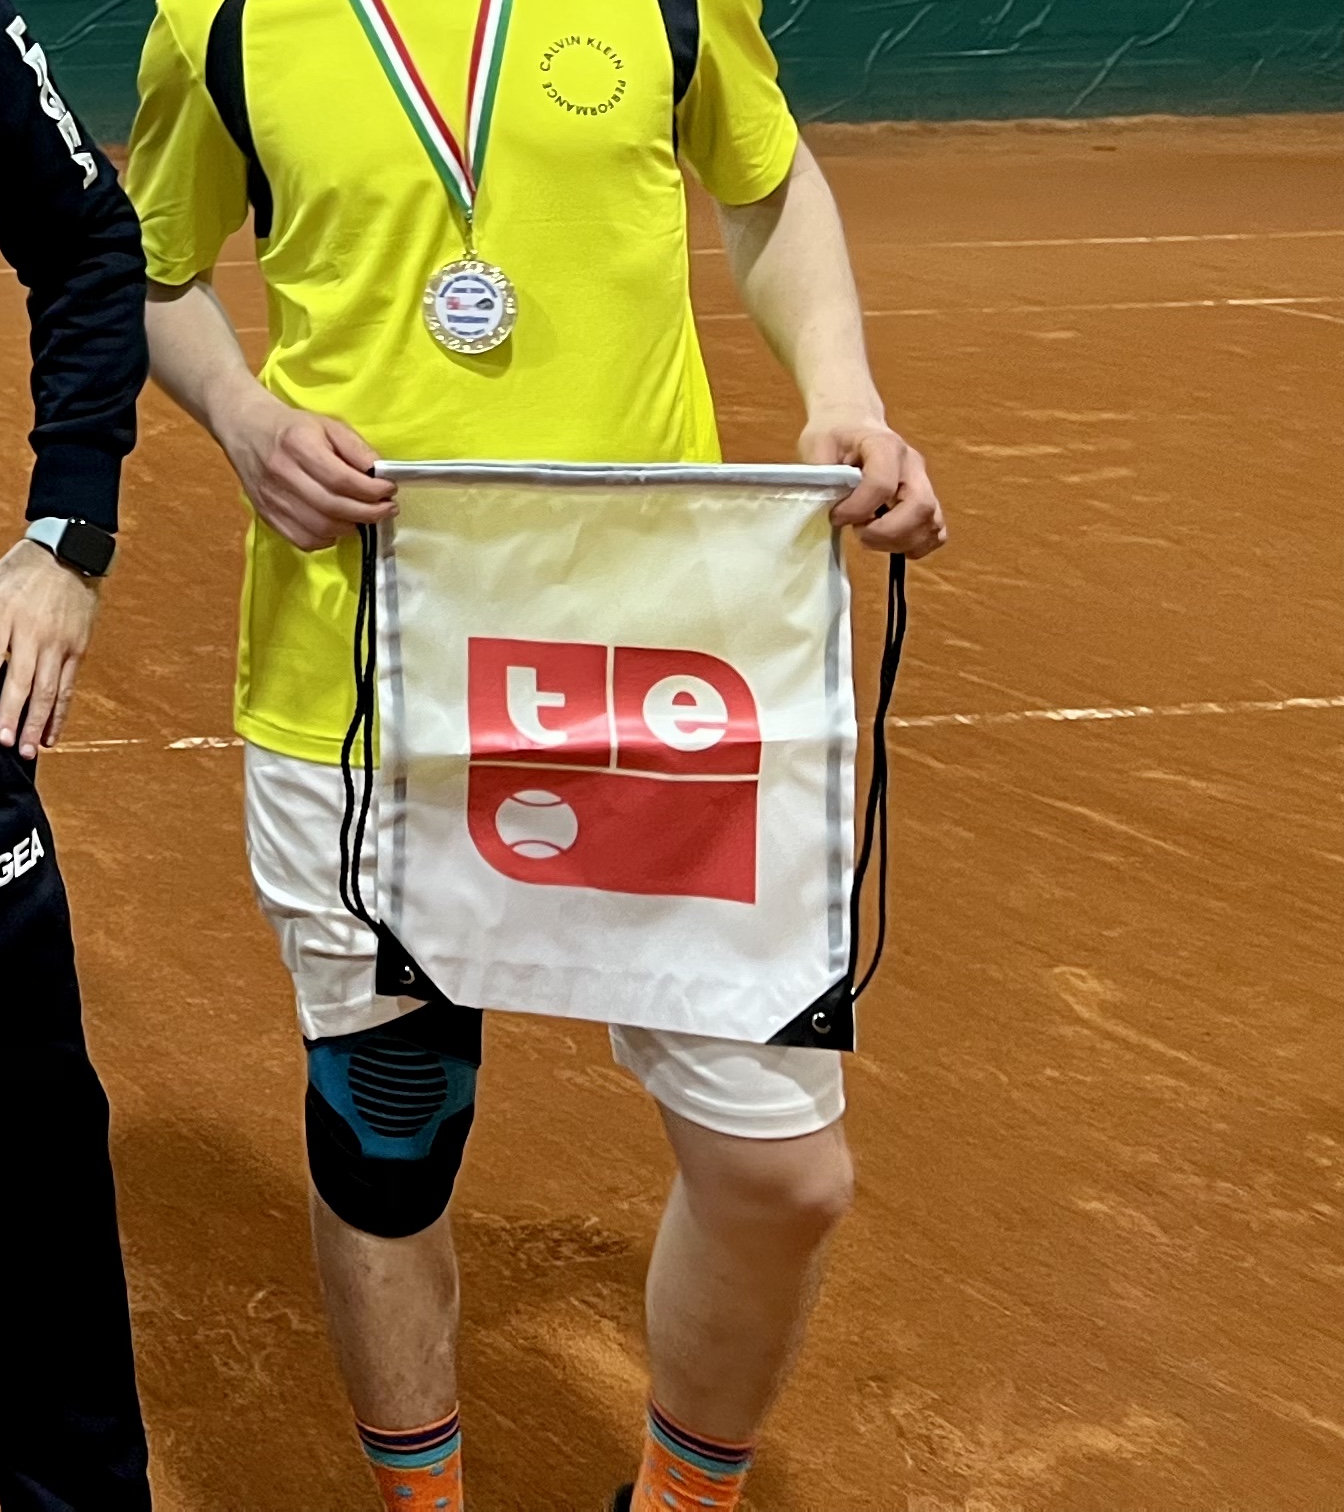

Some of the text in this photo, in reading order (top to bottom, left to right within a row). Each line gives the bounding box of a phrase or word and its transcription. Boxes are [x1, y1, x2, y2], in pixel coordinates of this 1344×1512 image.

[540, 35, 624, 71] CALVIN KLEIN
[542, 80, 626, 116] PERFORMANCE
